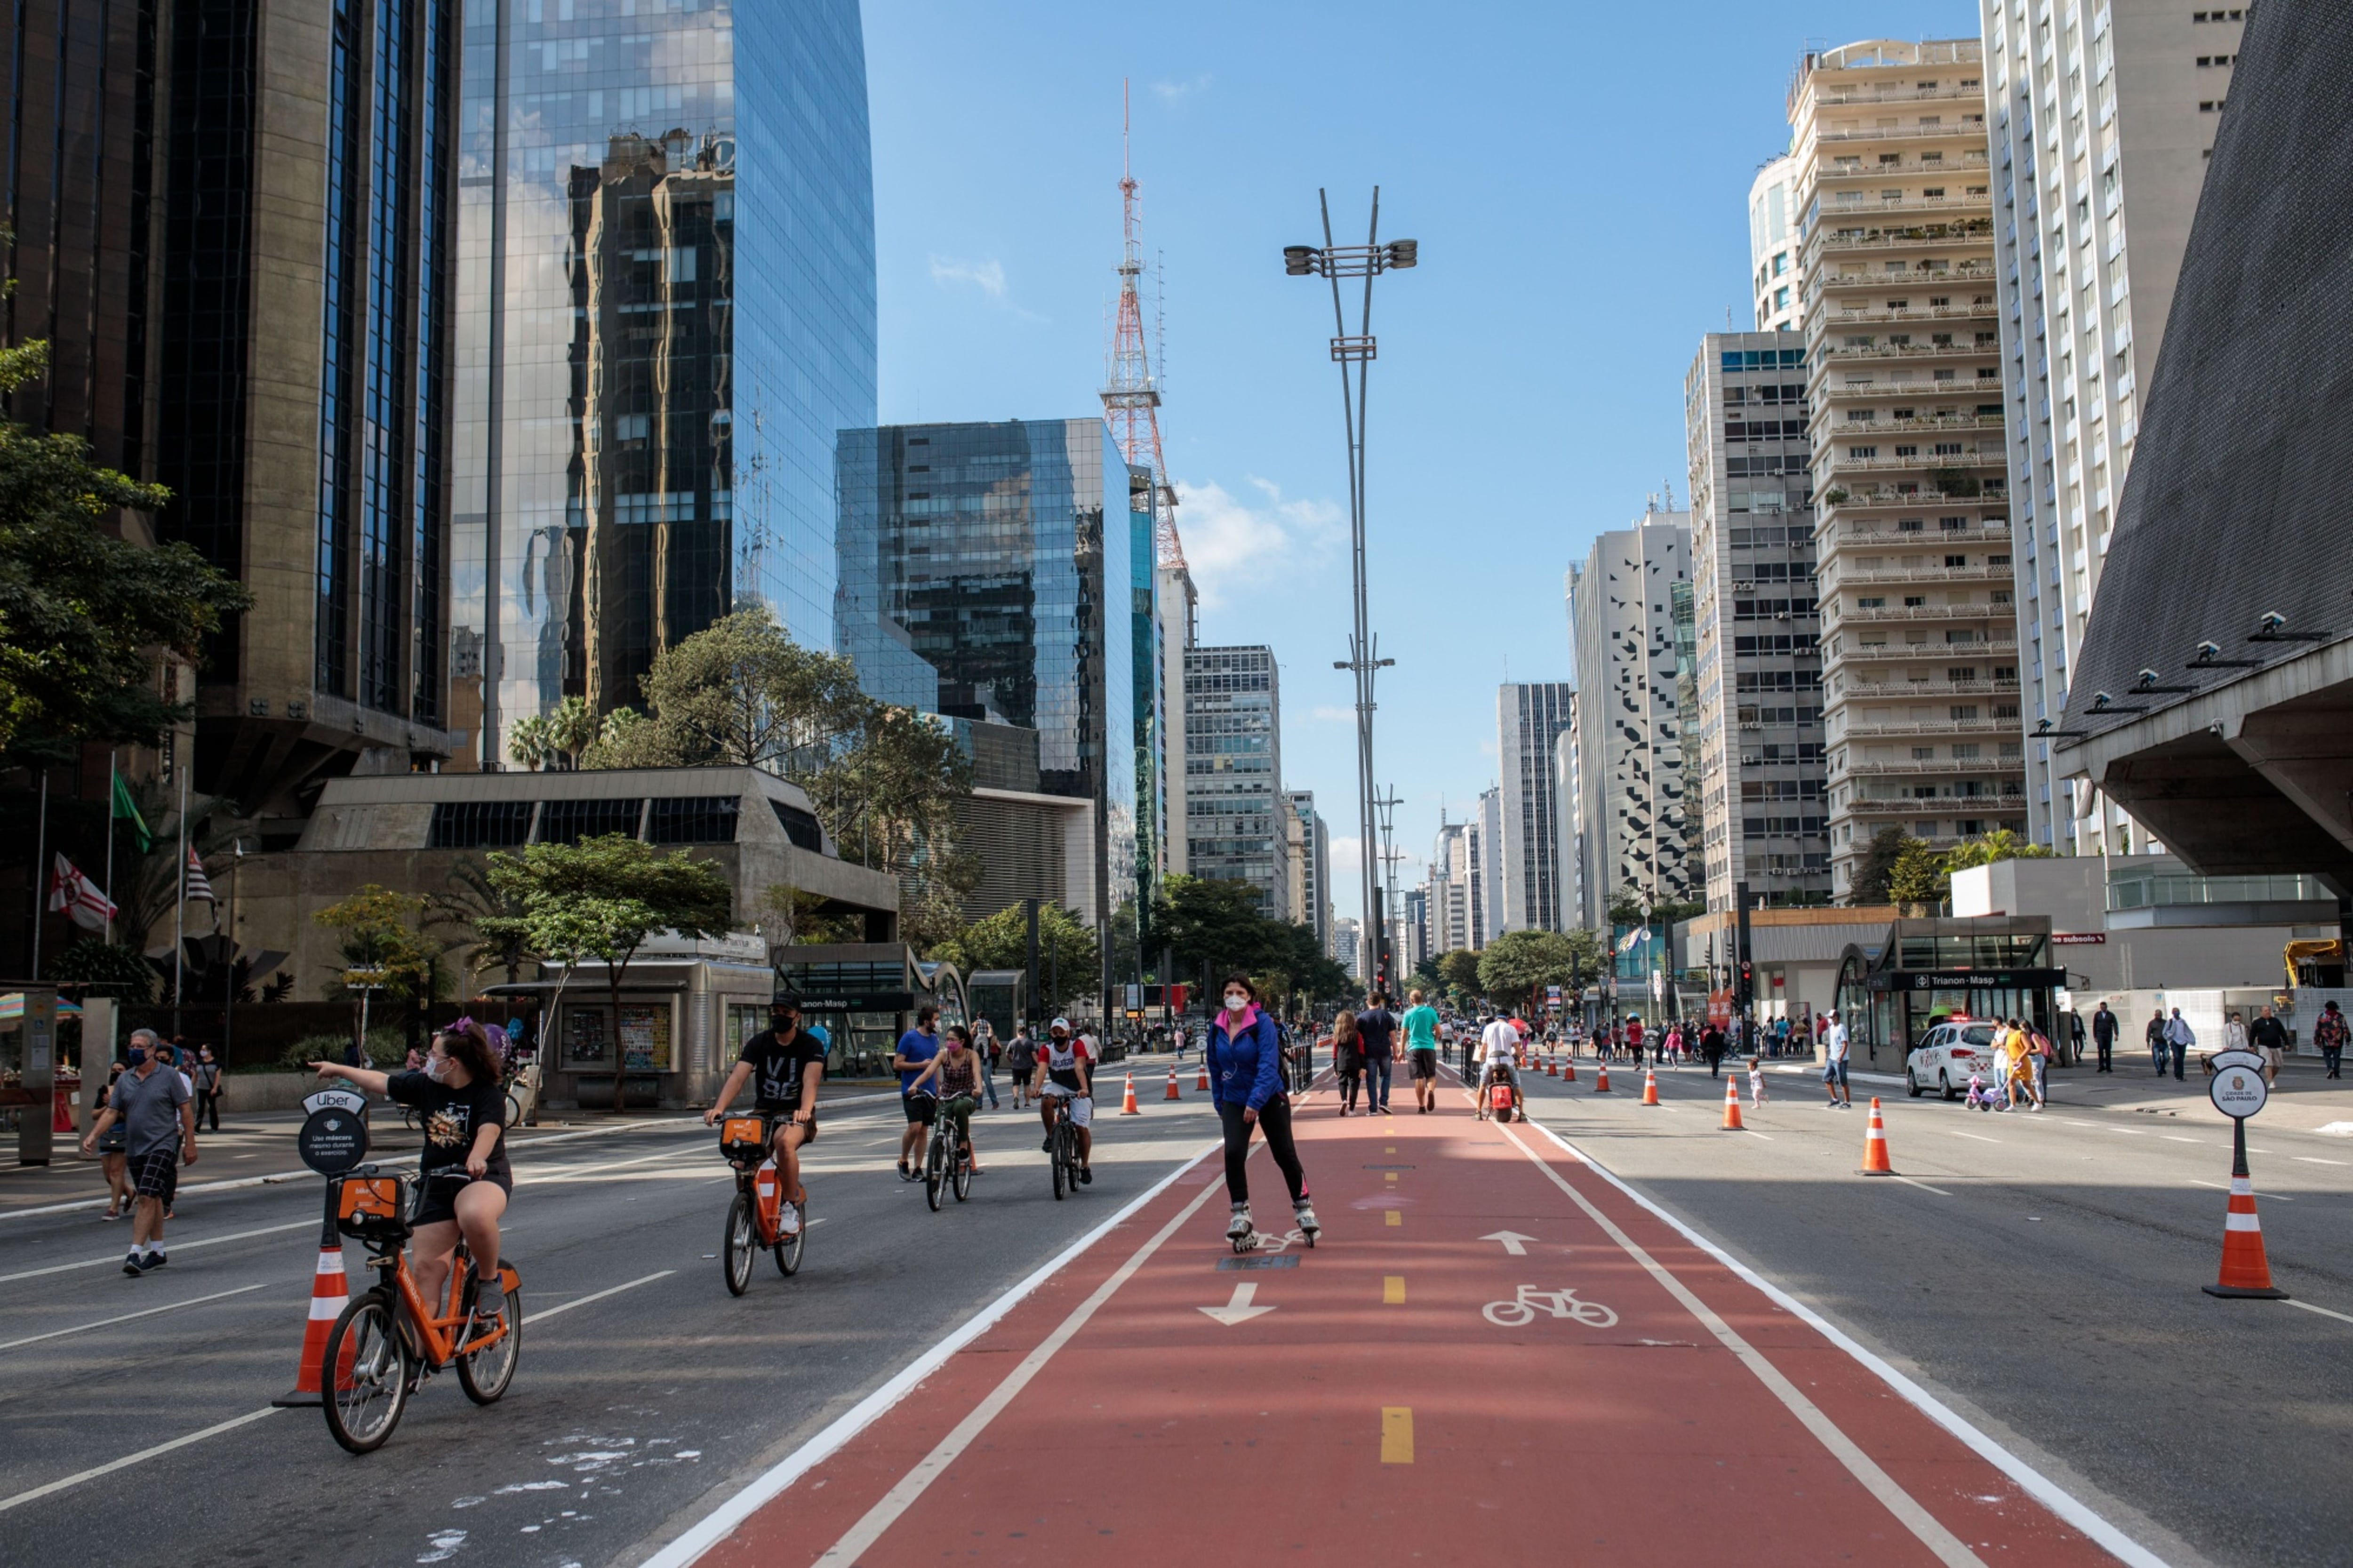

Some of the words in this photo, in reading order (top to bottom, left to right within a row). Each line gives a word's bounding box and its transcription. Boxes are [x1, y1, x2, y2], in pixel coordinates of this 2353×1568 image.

[2063, 935, 2096, 943] subsolo
[800, 1000, 847, 1008] anon-Masp
[317, 1094, 350, 1106] Uber
